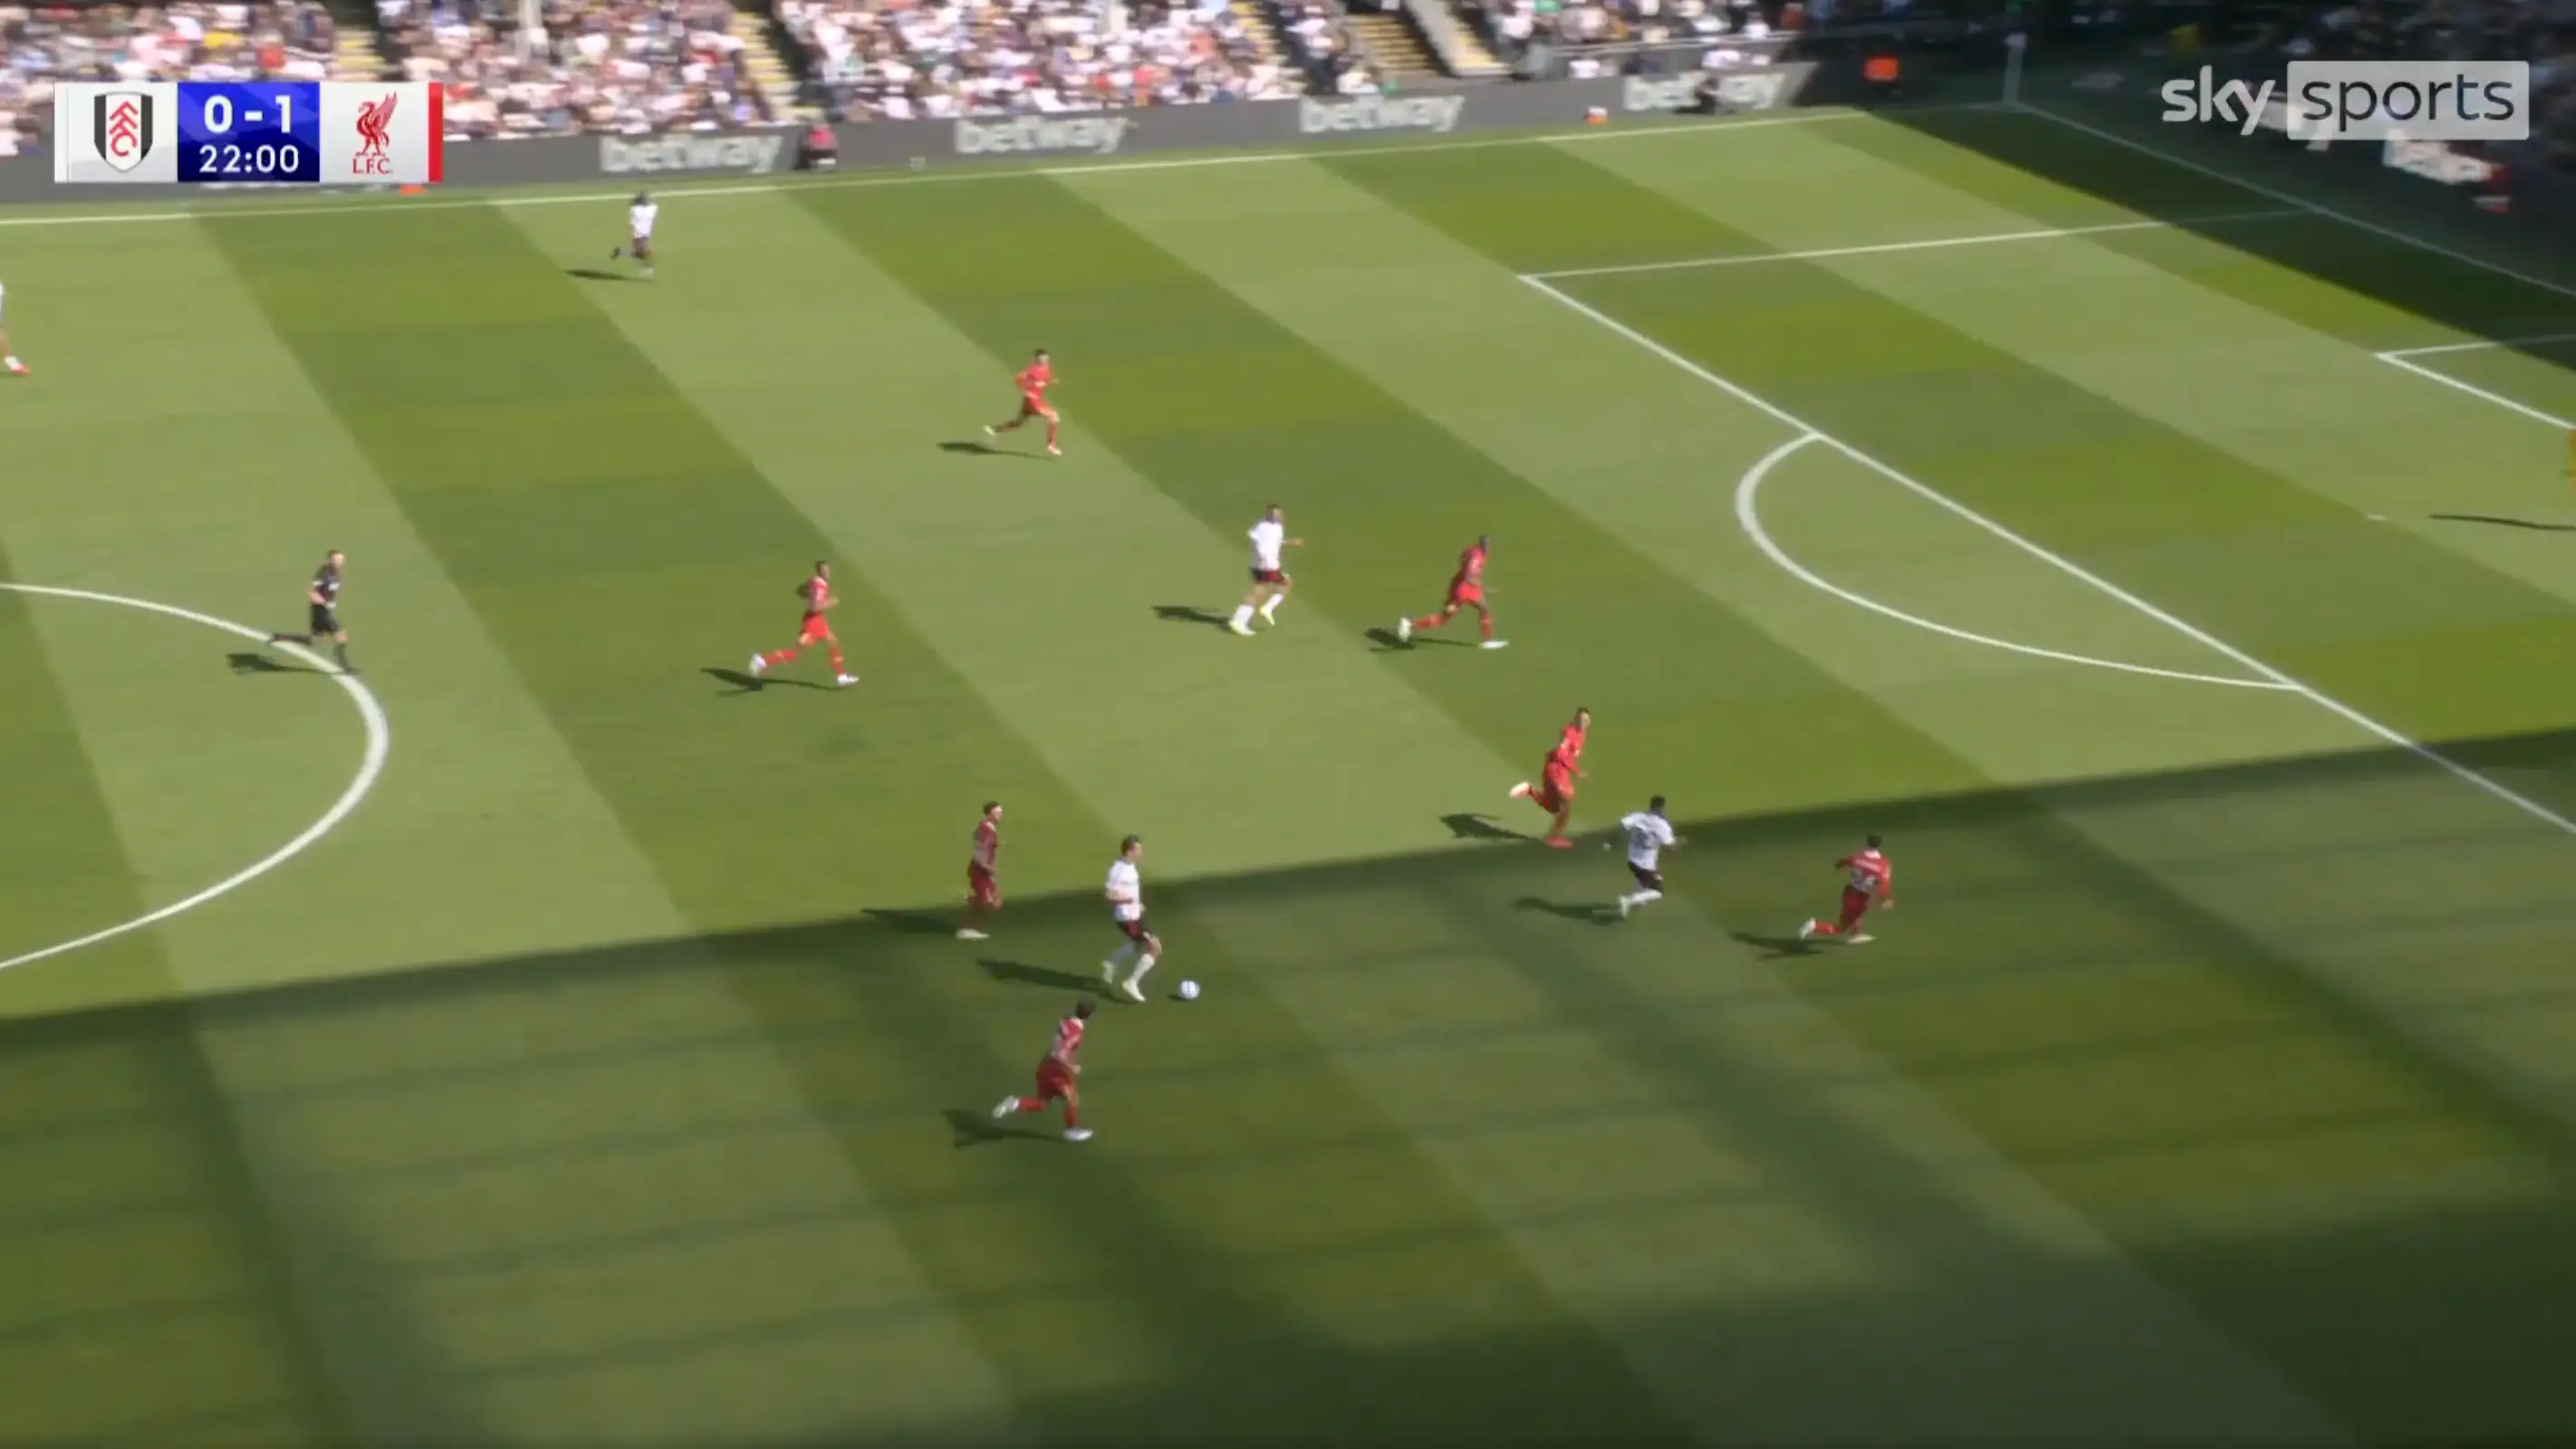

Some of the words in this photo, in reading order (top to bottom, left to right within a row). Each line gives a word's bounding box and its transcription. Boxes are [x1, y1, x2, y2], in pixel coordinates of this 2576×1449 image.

[1624, 72, 1785, 110] betay
[1299, 94, 1466, 133] betway
[600, 134, 783, 174] betway
[955, 115, 1129, 154] betway
